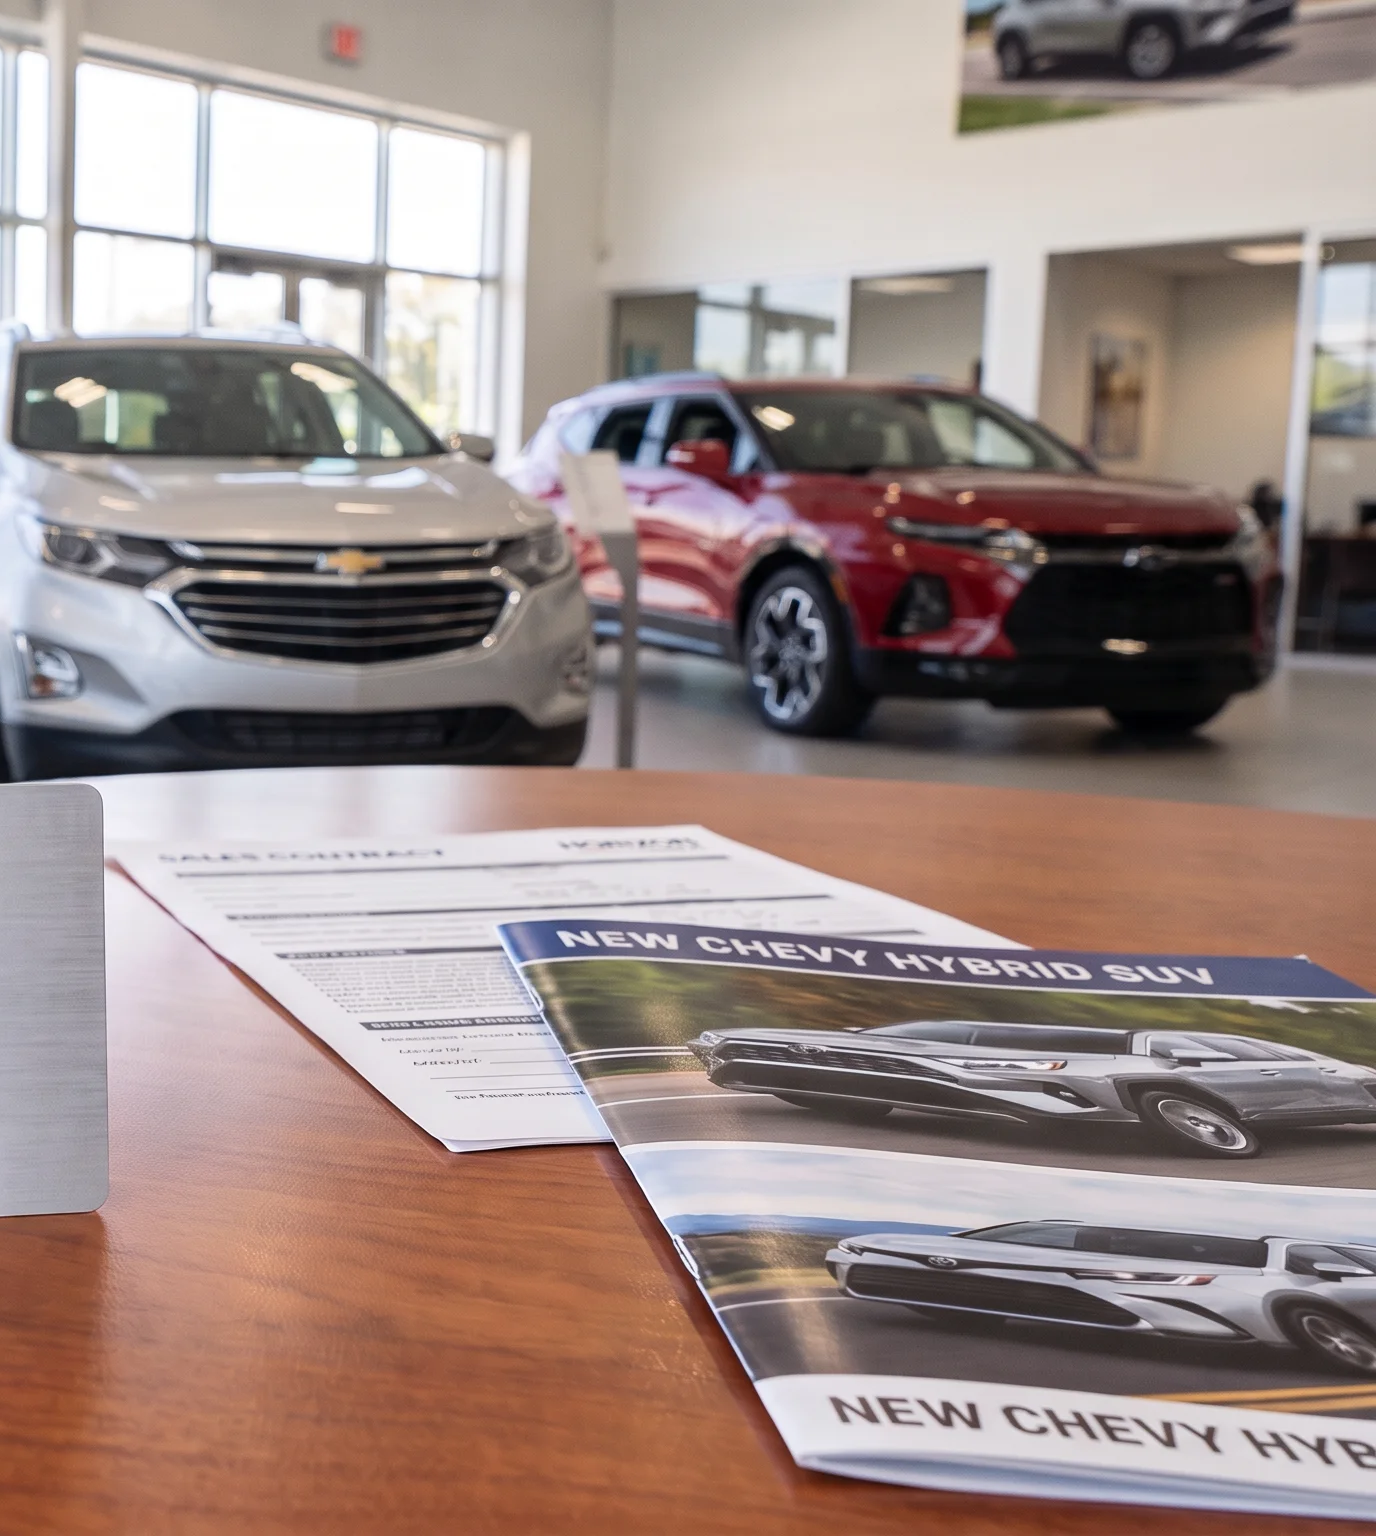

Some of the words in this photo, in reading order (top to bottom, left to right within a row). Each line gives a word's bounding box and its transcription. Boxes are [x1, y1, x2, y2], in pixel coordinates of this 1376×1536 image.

[158, 852, 261, 864] SALES
[268, 849, 444, 862] CONTRACT
[556, 930, 680, 950] NEW
[695, 936, 868, 967] CHEVY
[884, 951, 1093, 981] HYBRID
[1101, 964, 1215, 985] SUV
[829, 1396, 982, 1429] NEW
[1000, 1405, 1223, 1454] CHEVY
